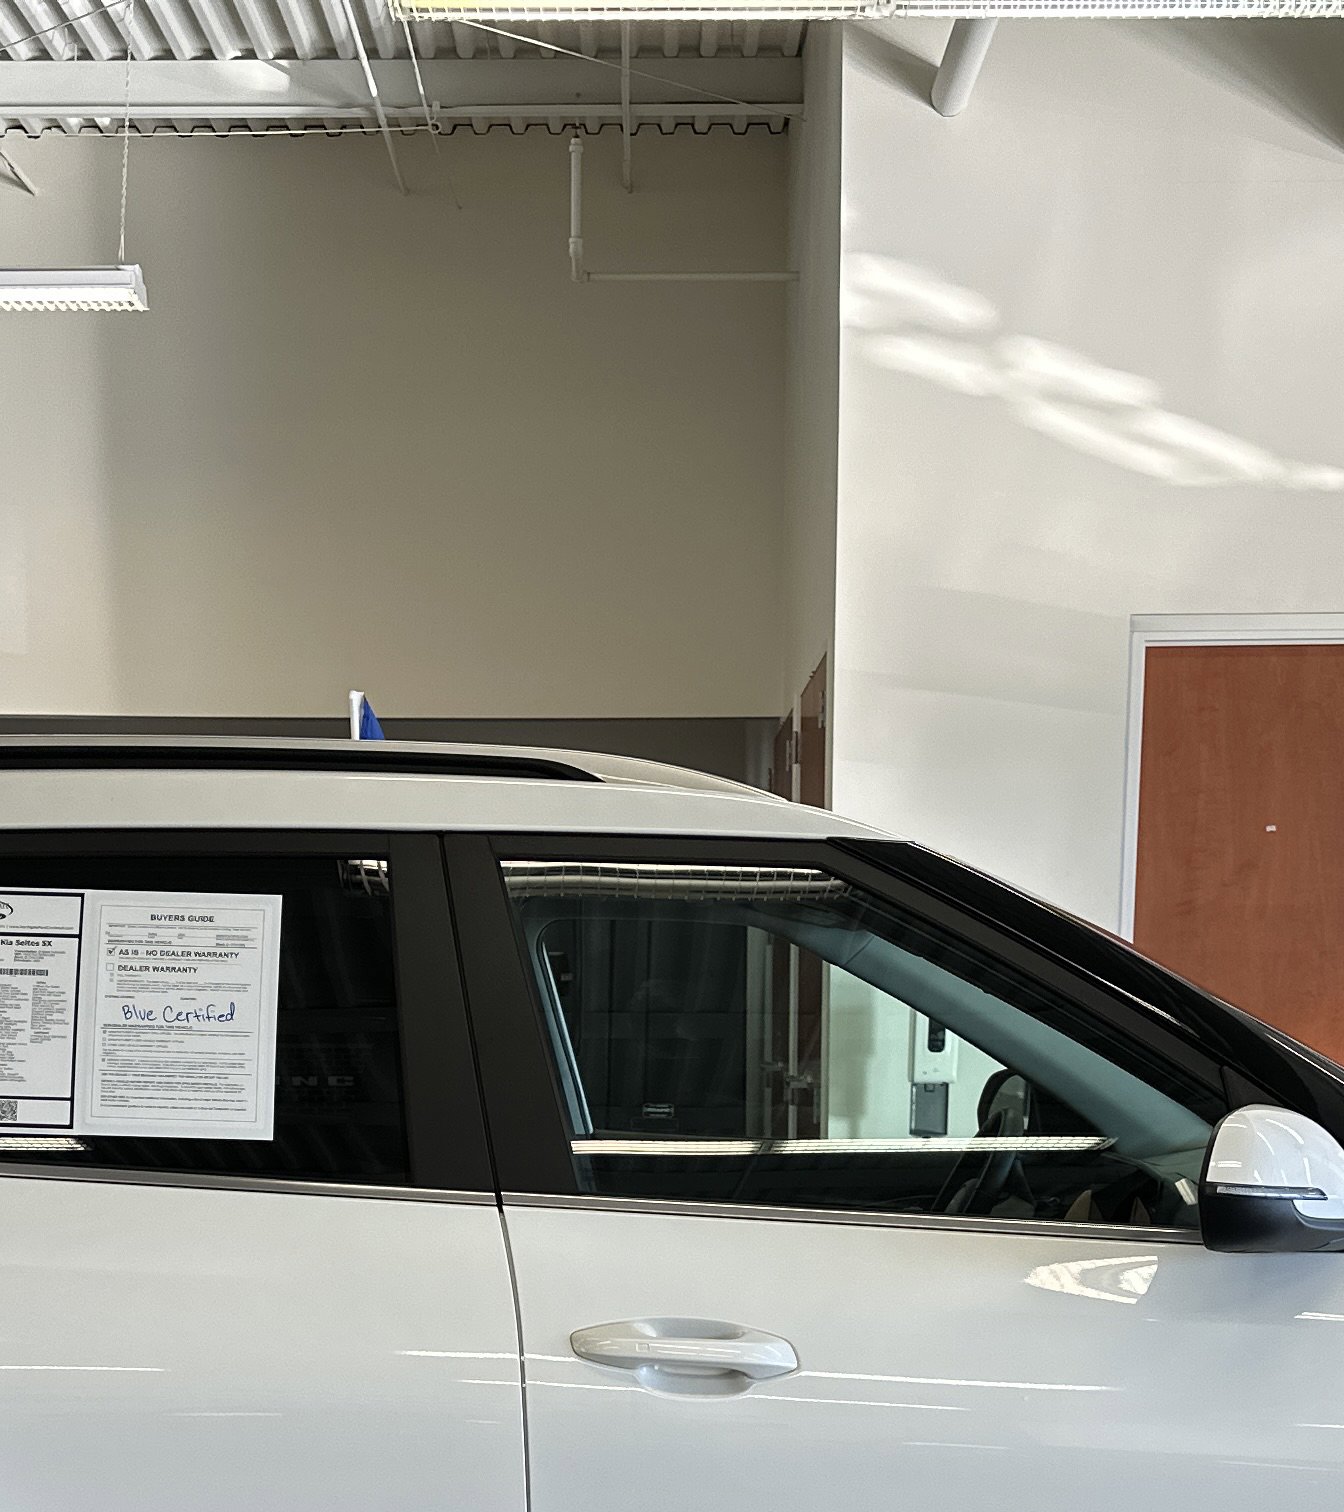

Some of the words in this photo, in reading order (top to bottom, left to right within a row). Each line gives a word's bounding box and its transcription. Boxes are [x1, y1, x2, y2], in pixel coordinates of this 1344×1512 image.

[150, 913, 186, 922] BUYERS
[188, 914, 215, 923] GUIDE
[159, 950, 192, 958] DEALER
[194, 951, 240, 959] WARRANTY
[118, 964, 151, 972] DEALER
[152, 965, 198, 974] WARRANTY
[121, 1003, 158, 1021] Blue
[162, 1001, 236, 1024] Certified
